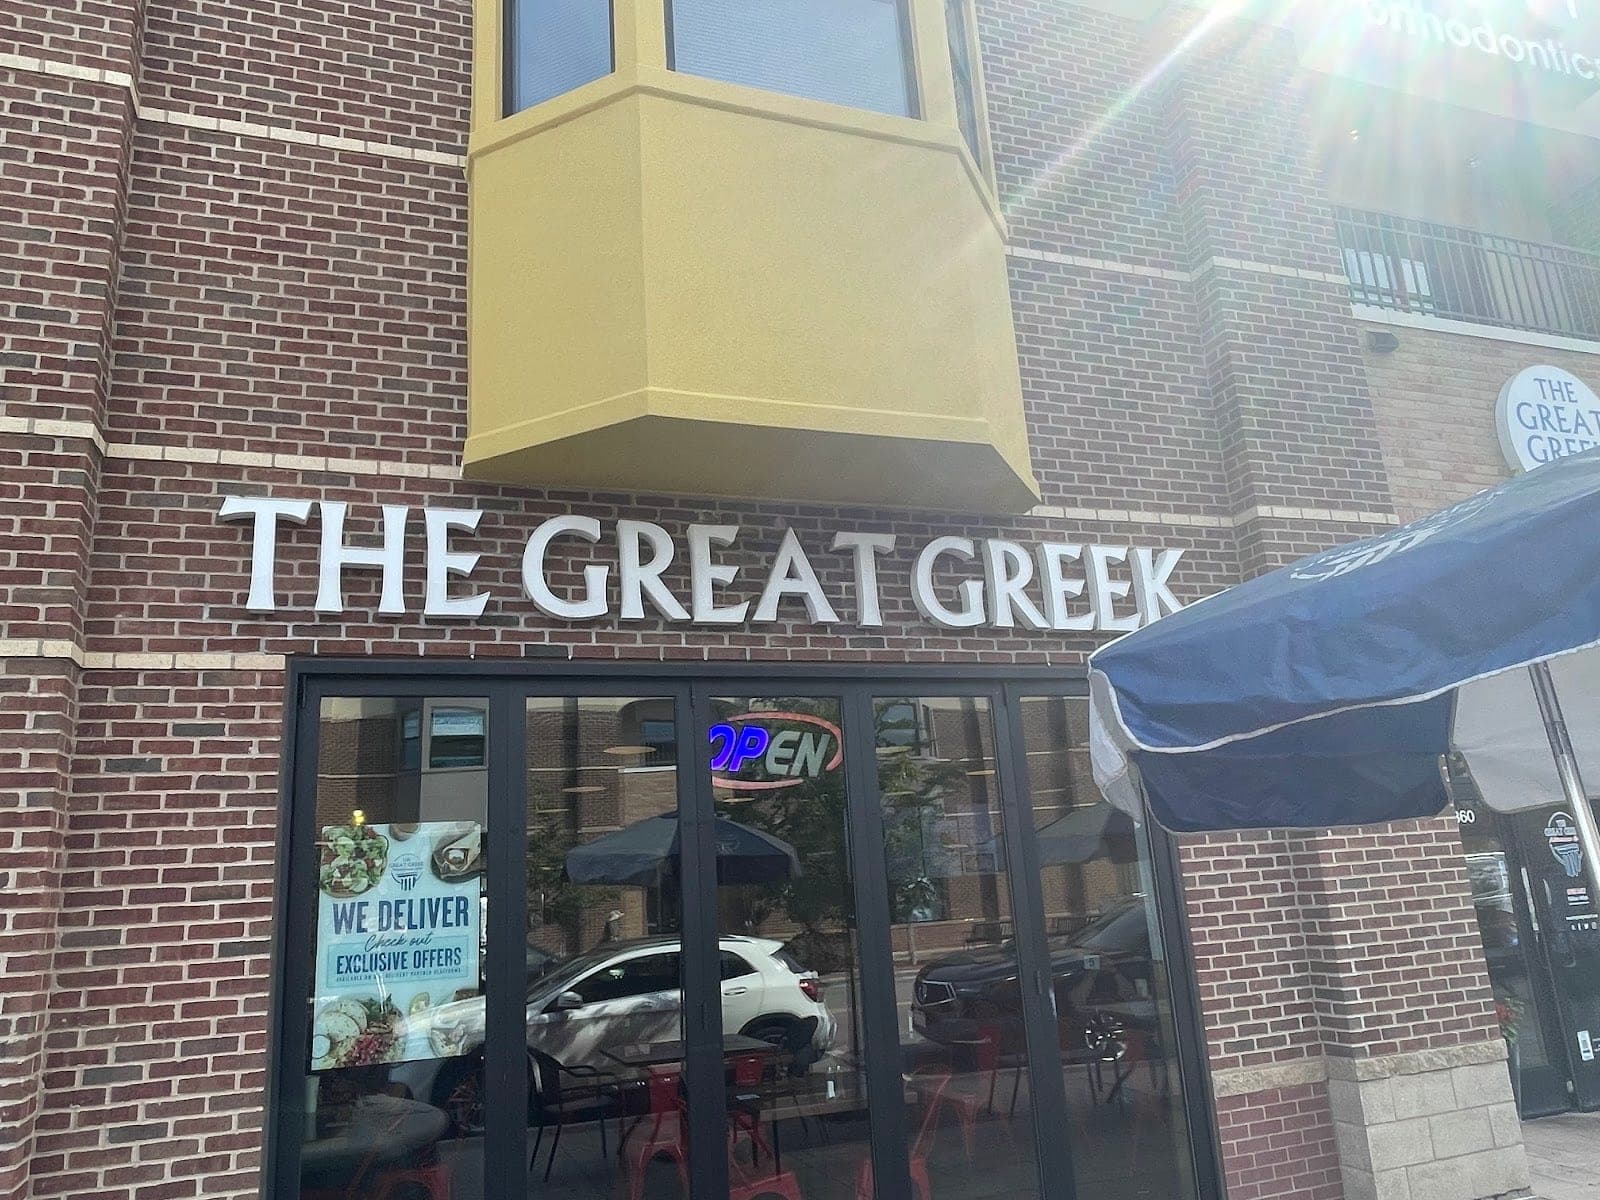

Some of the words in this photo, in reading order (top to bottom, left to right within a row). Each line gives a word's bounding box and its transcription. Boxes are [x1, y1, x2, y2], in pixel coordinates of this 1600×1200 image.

[1533, 378, 1578, 403] THE
[1516, 402, 1600, 436] GREAT
[1527, 435, 1598, 463] GRE
[219, 495, 491, 618] THE
[521, 513, 897, 626] GREAT
[909, 534, 1186, 632] GREEK
[709, 723, 831, 778] OPEN
[332, 901, 369, 935] WE
[378, 895, 469, 932] DELIVER
[364, 933, 407, 953] Check
[409, 931, 433, 948] out
[336, 951, 408, 975] EXCLUSIVE
[413, 947, 462, 969] OFFERS
